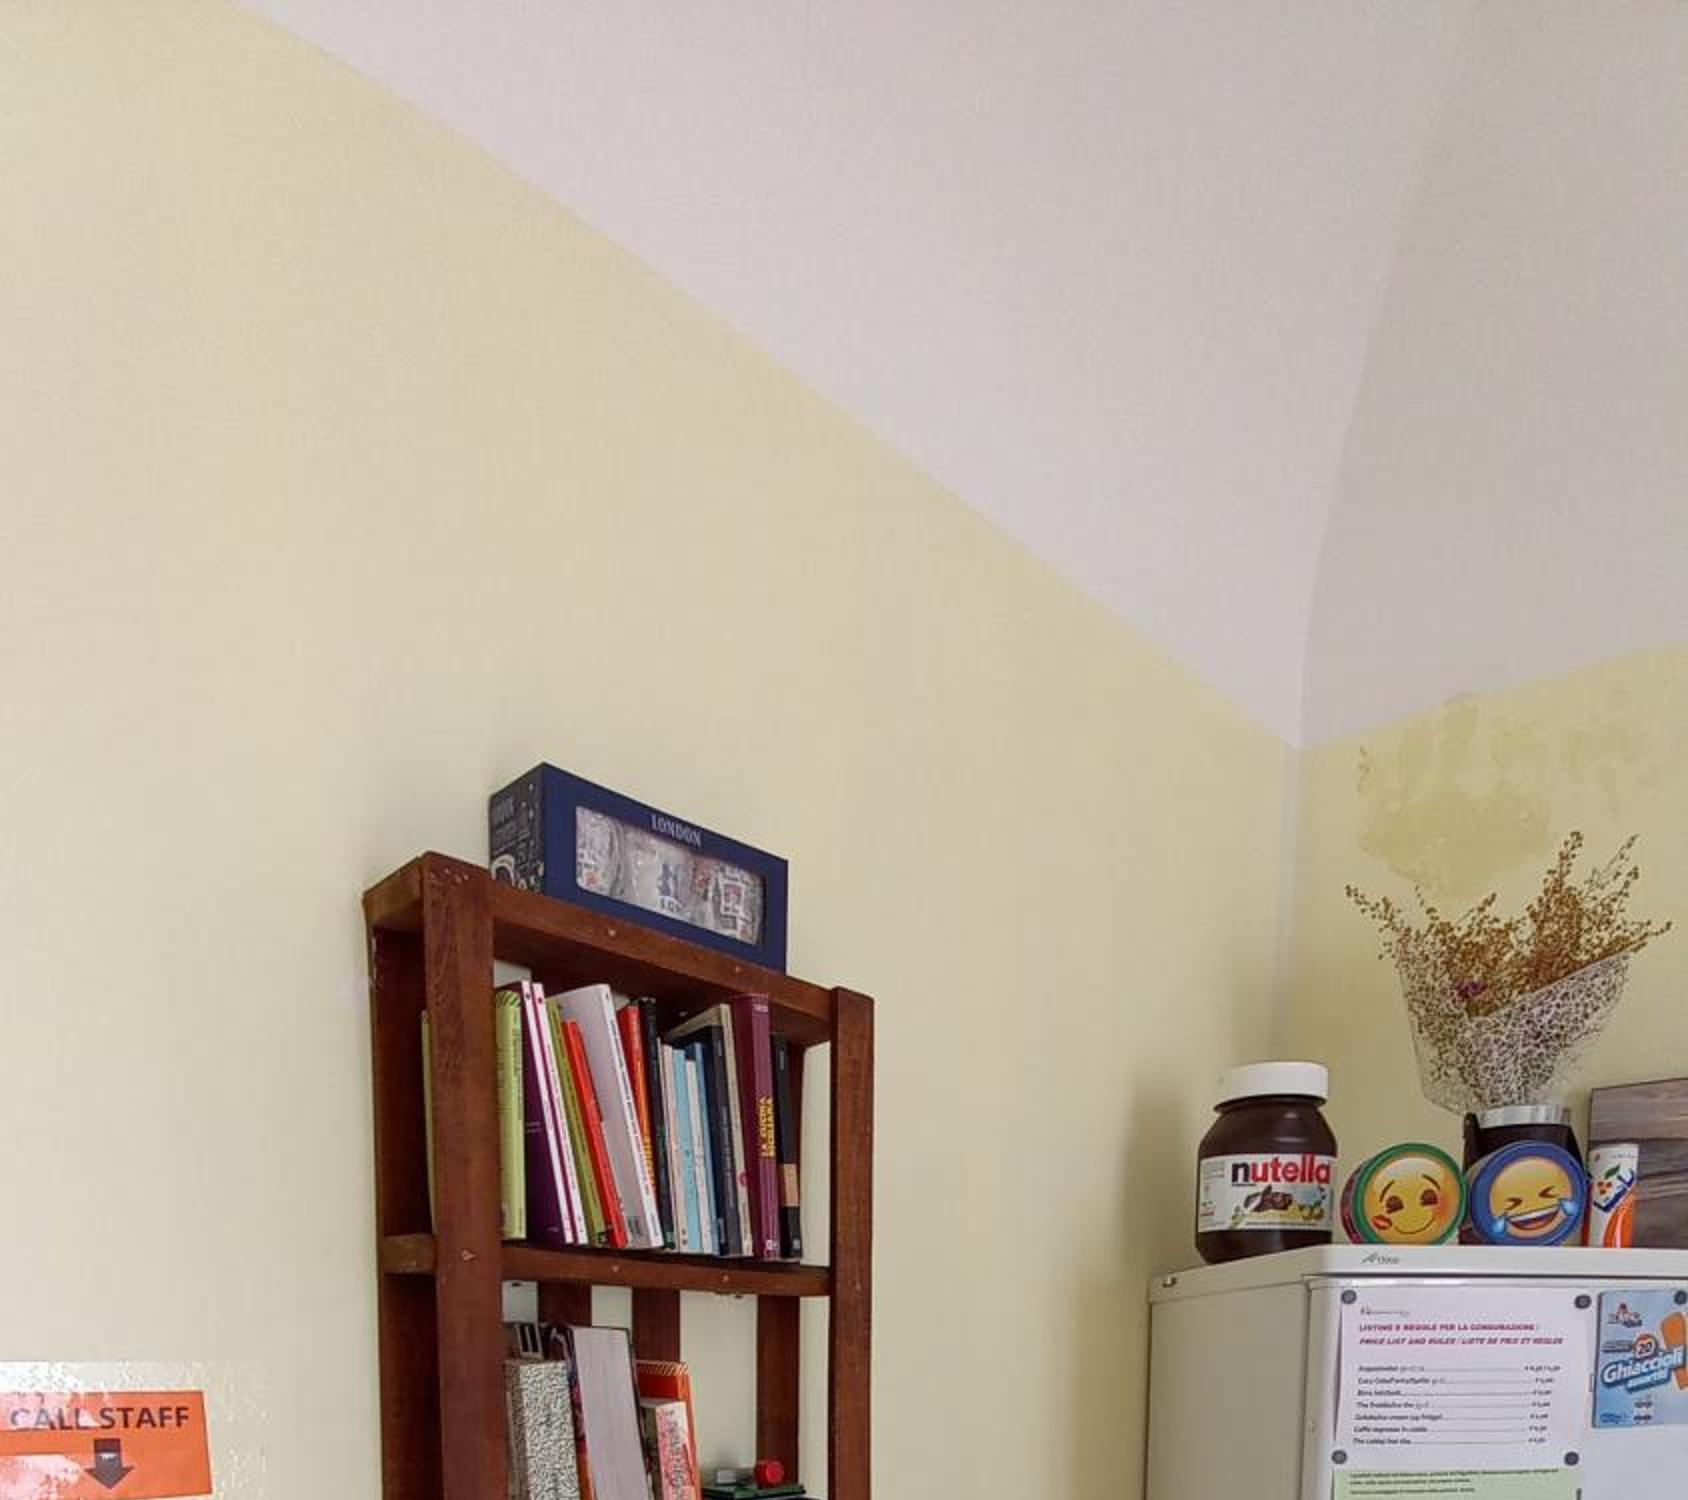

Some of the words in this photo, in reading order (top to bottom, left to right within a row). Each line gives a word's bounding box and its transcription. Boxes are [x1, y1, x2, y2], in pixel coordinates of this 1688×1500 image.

[651, 814, 702, 848] LONDON
[1231, 1153, 1330, 1184] nutella
[1637, 1340, 1653, 1357] 20
[1601, 1346, 1683, 1384] Ghiaccioli
[10, 1407, 97, 1430] CALL
[99, 1406, 190, 1430] STAFF
